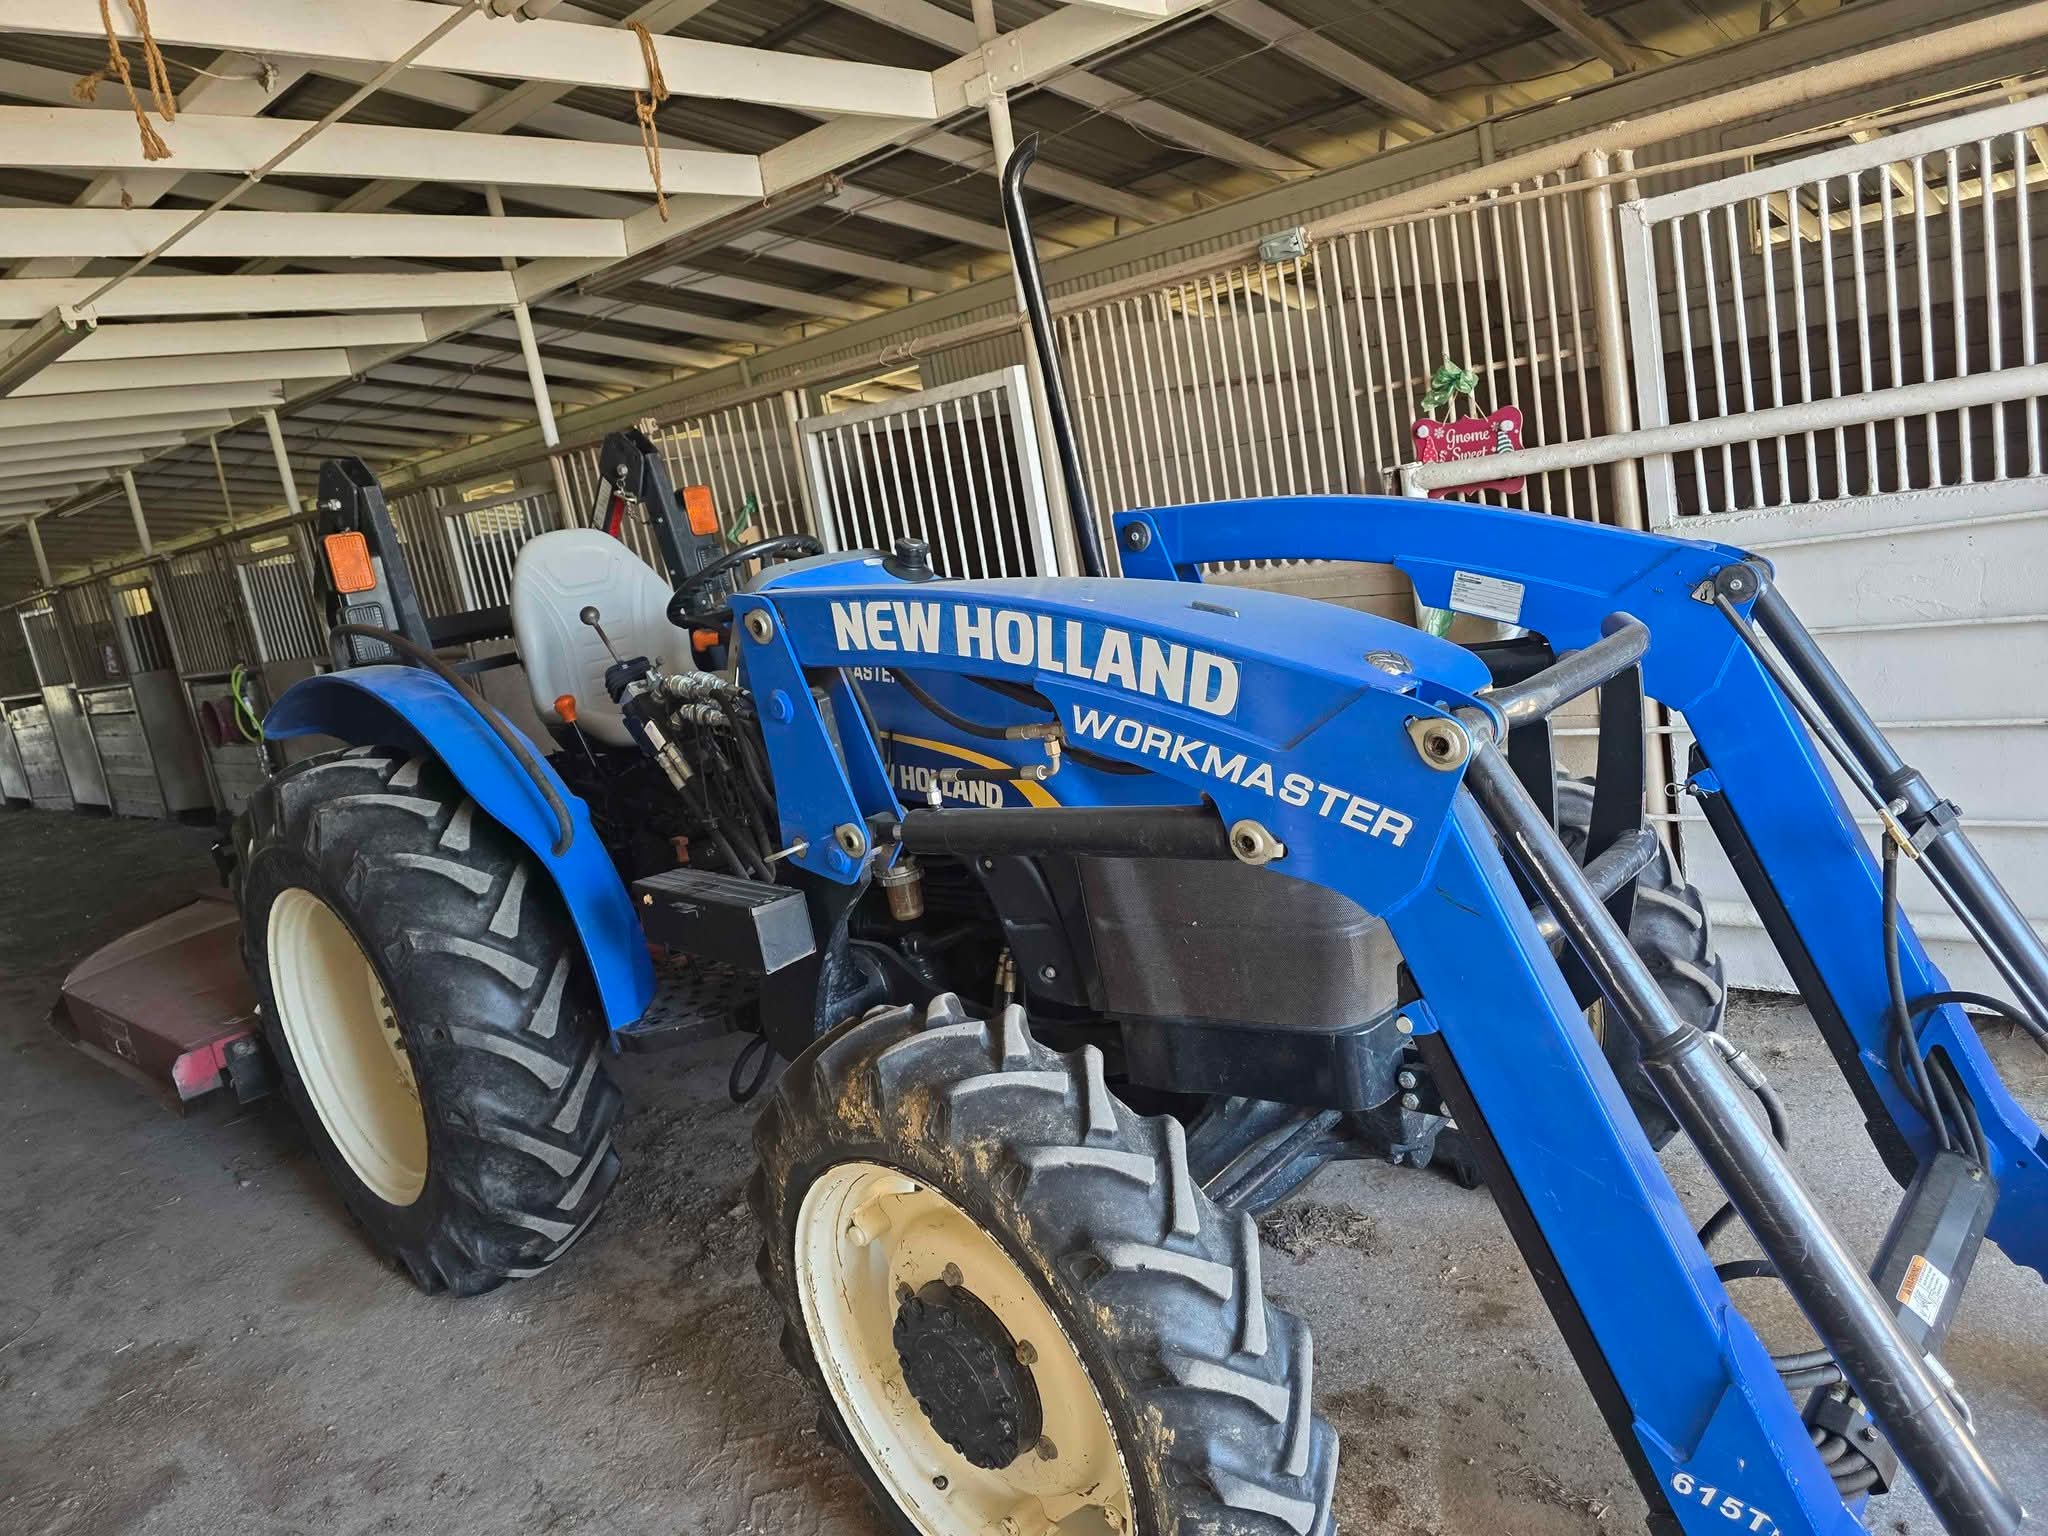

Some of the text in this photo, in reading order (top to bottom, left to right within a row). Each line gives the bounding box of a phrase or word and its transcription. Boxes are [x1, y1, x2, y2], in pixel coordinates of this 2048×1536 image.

[1446, 428, 1490, 450] Gnome
[1452, 446, 1488, 460] Sweet
[831, 602, 1240, 716] NEW HOLLAND
[900, 765, 1004, 809] HOLAND
[1072, 705, 1414, 847] WORKMASTER
[1673, 1473, 1781, 1536] 615T
